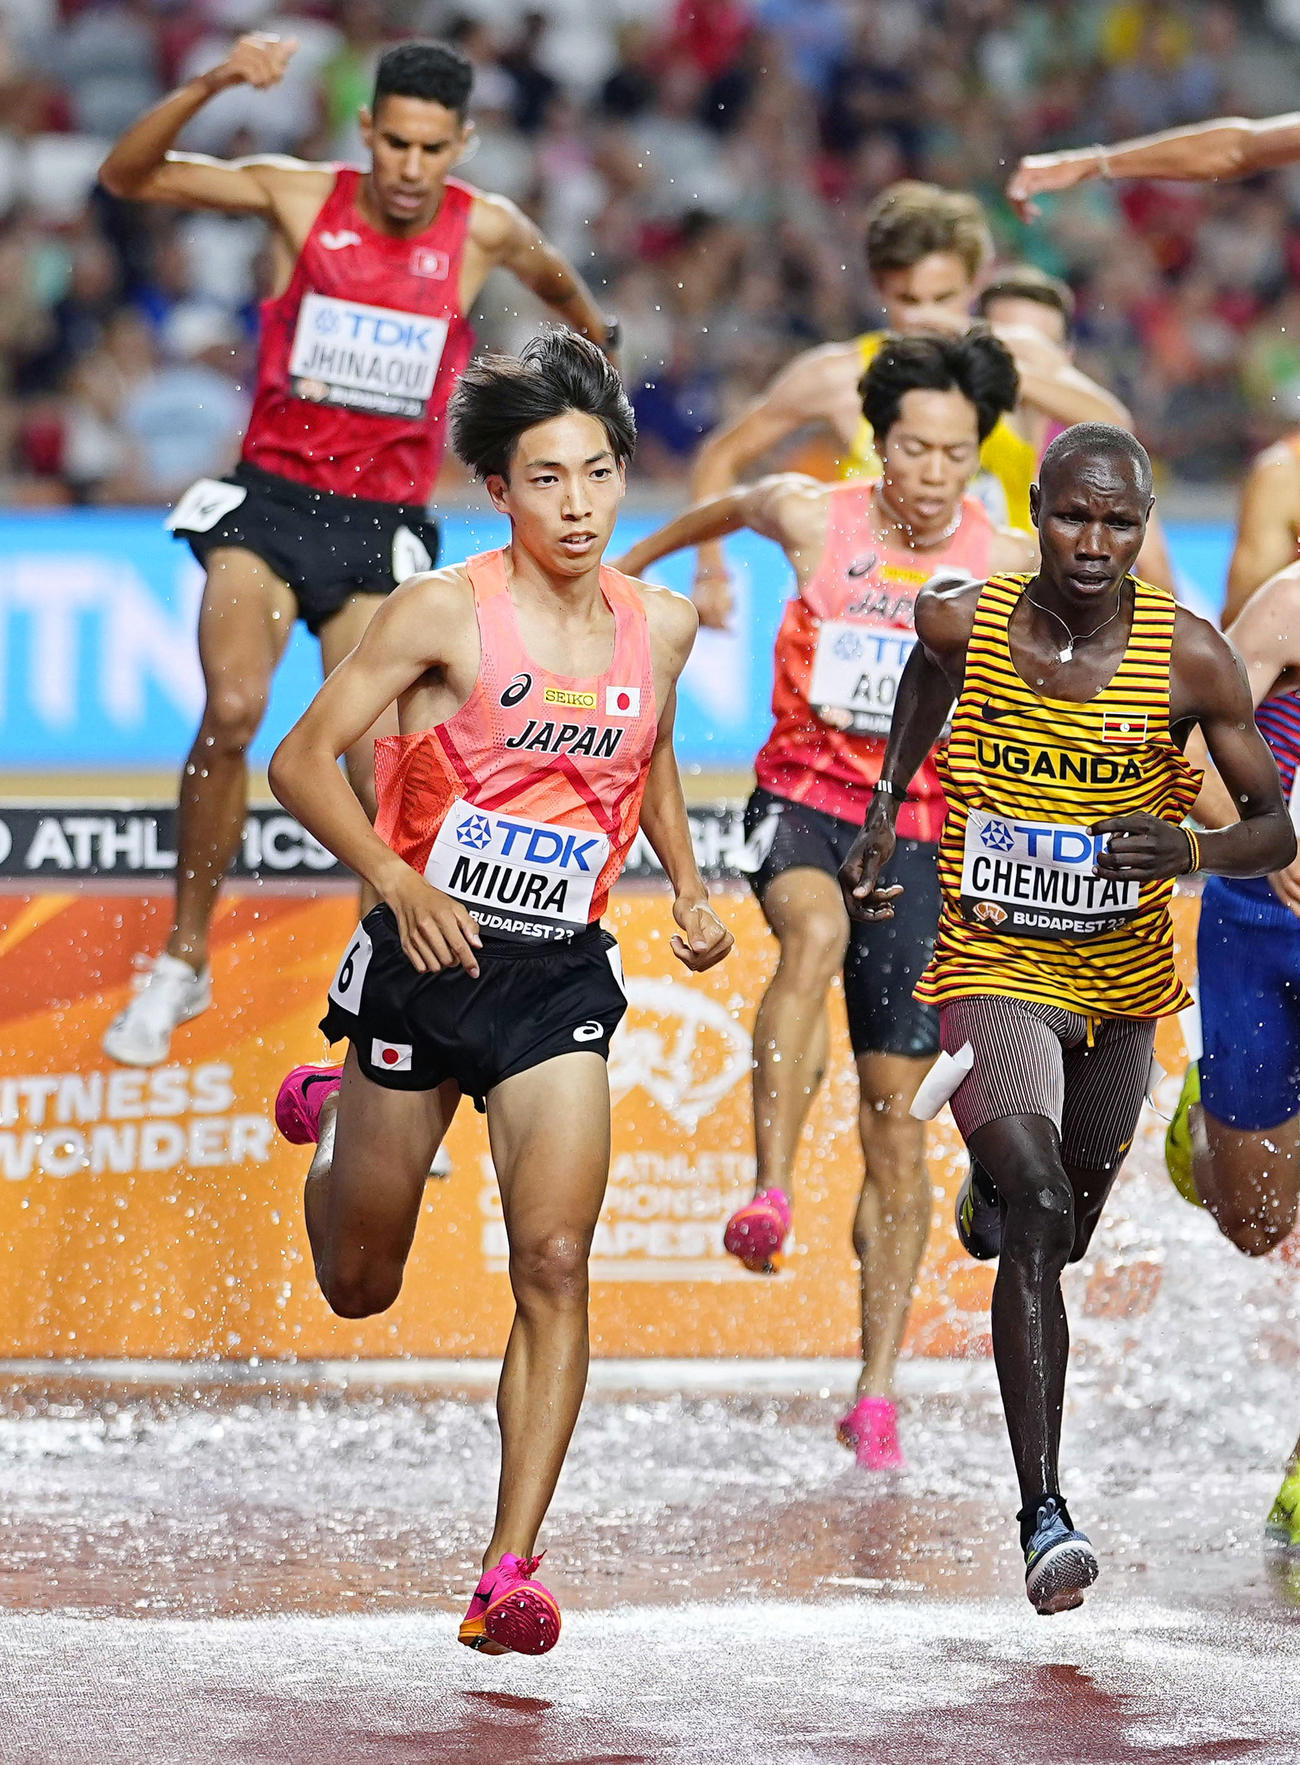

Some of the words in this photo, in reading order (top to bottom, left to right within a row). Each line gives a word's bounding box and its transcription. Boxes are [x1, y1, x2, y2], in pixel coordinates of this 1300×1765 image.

[345, 310, 431, 351] TDK
[545, 689, 594, 707] SEIKO
[505, 718, 624, 759] JAPAN
[976, 738, 1142, 784] UGANDA
[496, 820, 600, 872] TDK
[448, 855, 569, 914] MIURA
[972, 856, 1131, 909] CHEMUTAI
[1013, 910, 1106, 934] BUDAPEST
[338, 943, 360, 993] 6
